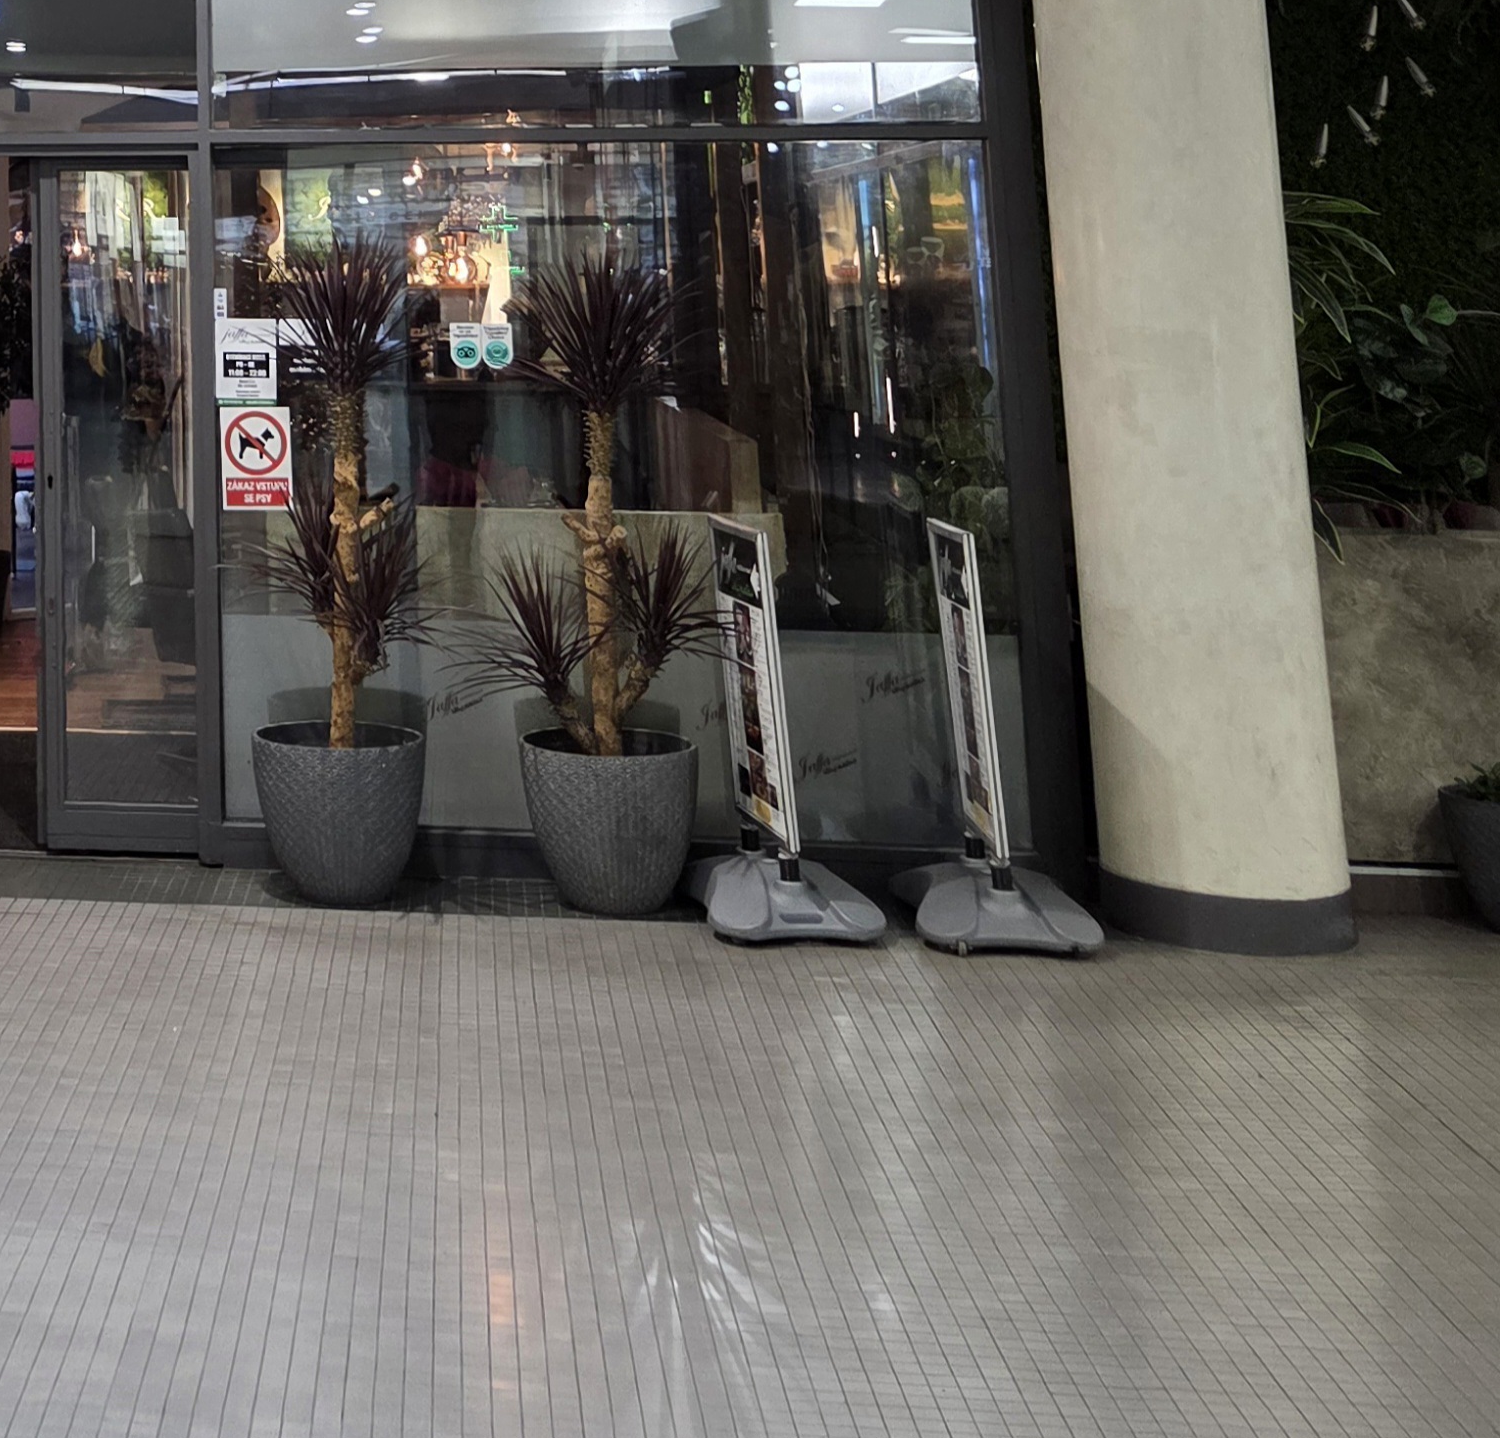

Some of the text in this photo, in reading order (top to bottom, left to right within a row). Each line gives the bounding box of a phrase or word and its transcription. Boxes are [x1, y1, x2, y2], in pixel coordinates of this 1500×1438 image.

[227, 479, 254, 491] ZÁKAZ
[244, 493, 272, 503] SE PSY
